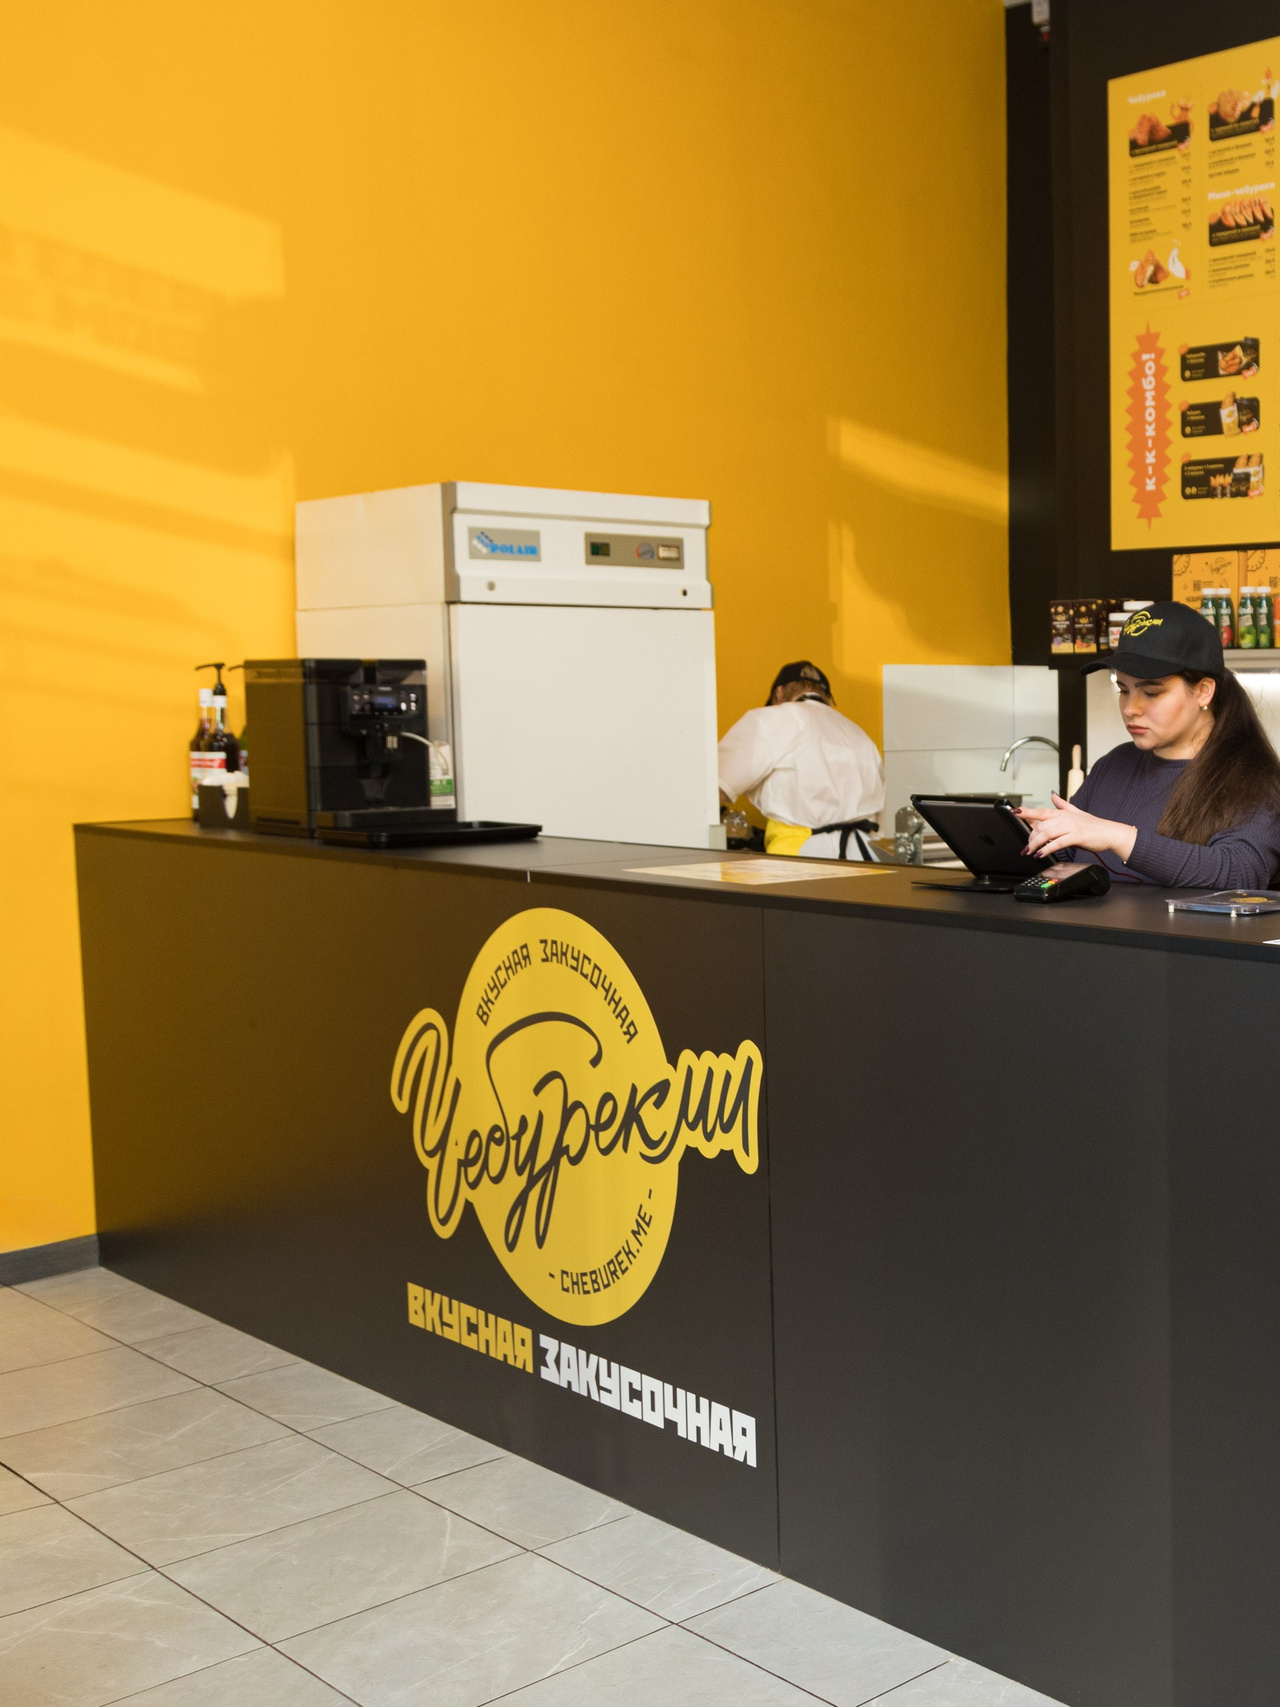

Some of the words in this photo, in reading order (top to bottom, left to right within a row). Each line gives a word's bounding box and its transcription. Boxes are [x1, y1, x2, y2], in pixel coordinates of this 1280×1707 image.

[489, 543, 538, 556] POLAIR
[476, 942, 532, 1027] ВКУСНАЯ
[540, 938, 639, 1045] ЗАКУСОЧНАЯ
[561, 1209, 654, 1296] CHEBUREK.ME
[406, 1282, 534, 1374] ВКУСНАЯ
[539, 1334, 758, 1468] ЗАКУСОЧНАЯ
